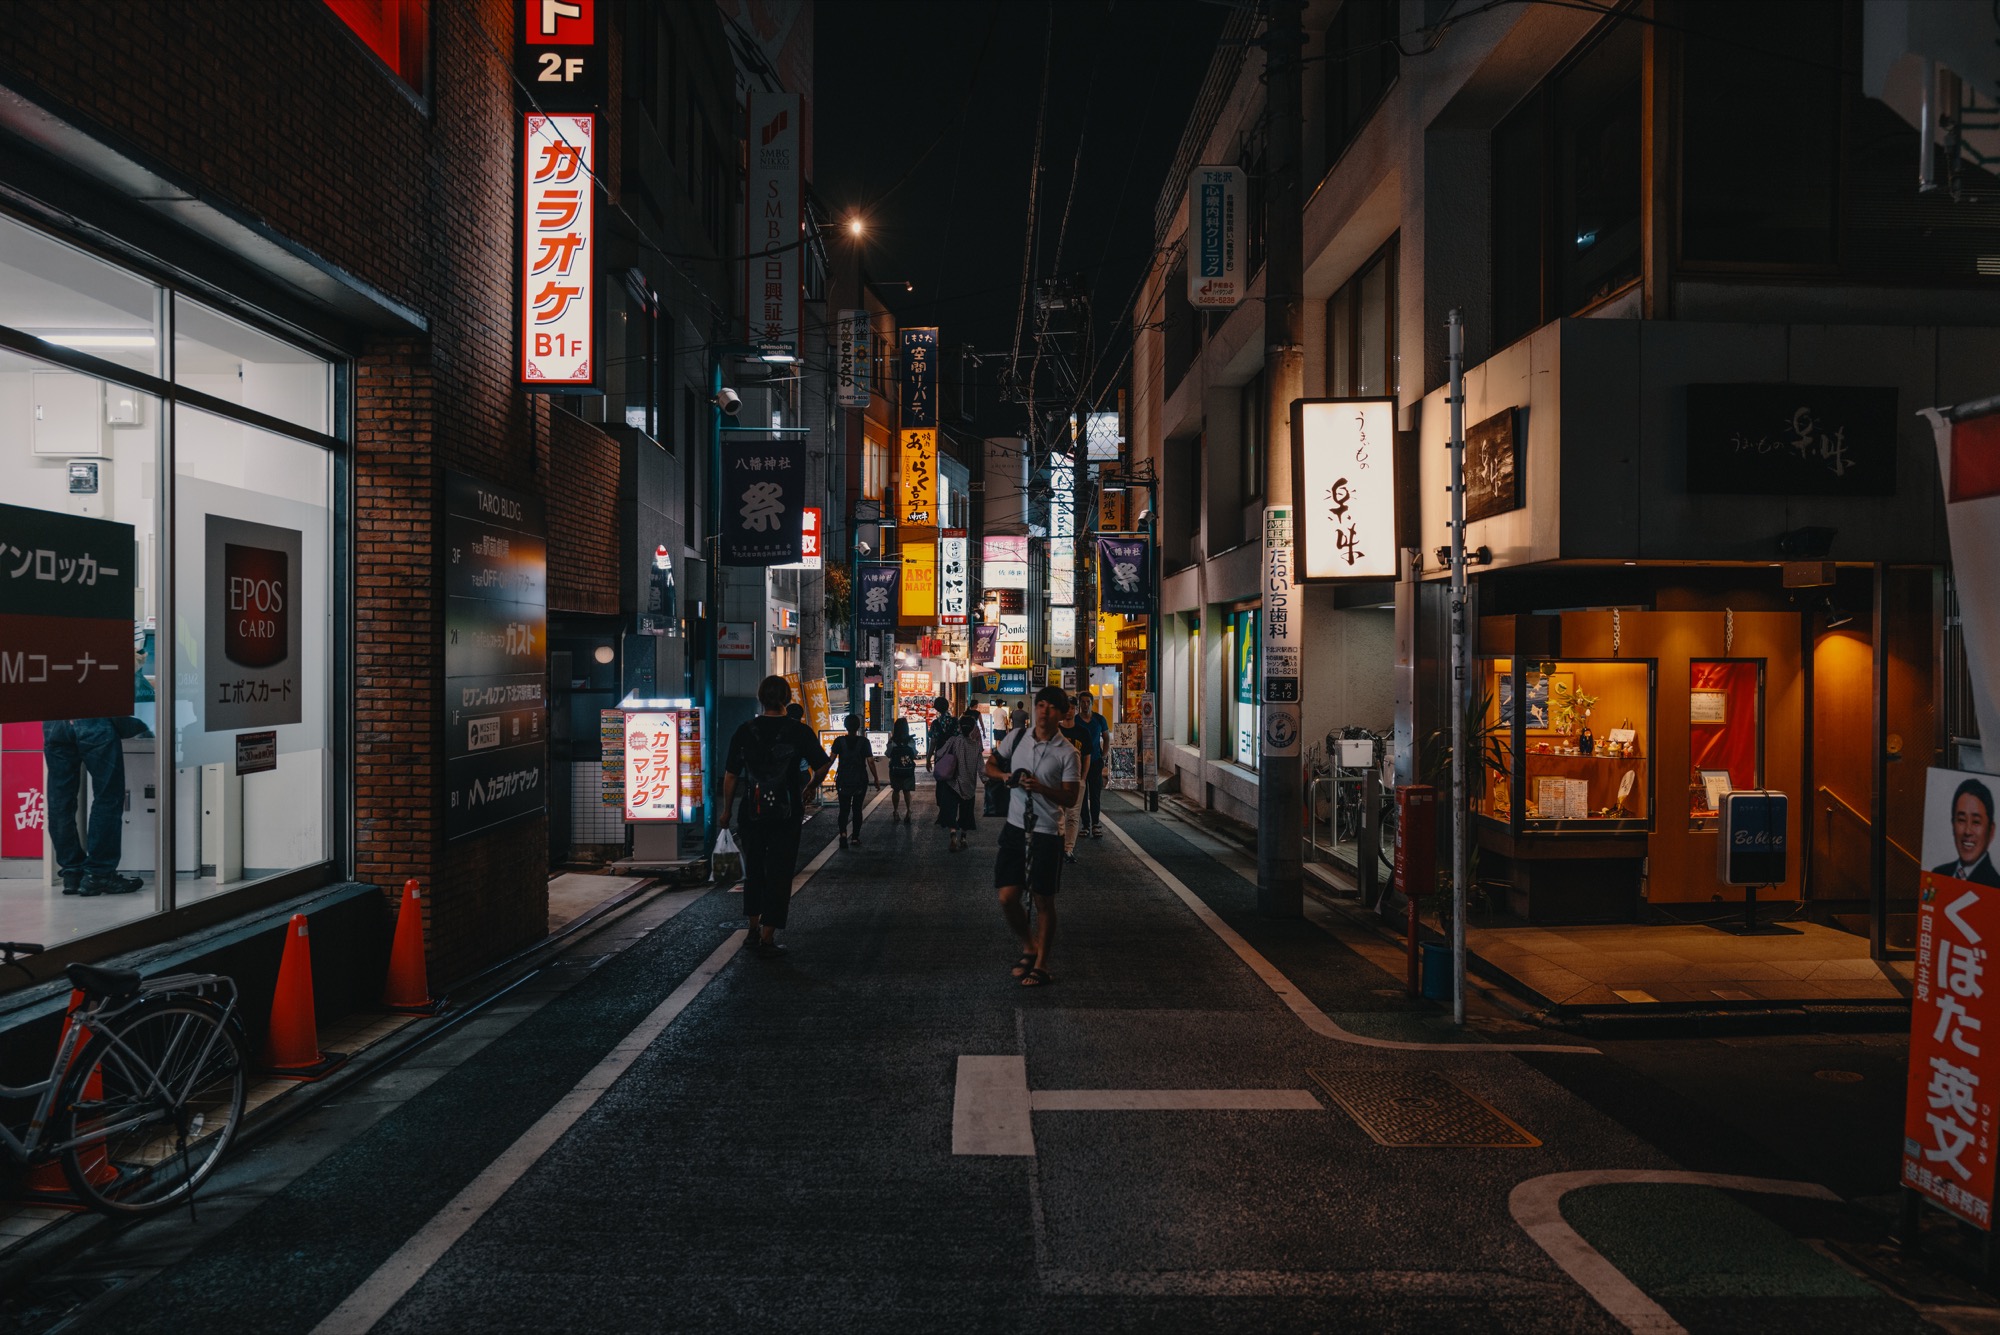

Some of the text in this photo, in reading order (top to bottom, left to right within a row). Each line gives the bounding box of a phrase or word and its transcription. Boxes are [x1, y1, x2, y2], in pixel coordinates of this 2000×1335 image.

[537, 52, 584, 82] 2F
[760, 149, 790, 158] SMBC
[760, 158, 790, 166] NIKKO
[1203, 172, 1233, 183] 下北沢
[531, 139, 587, 326] カラオケ
[1205, 185, 1220, 277] 心療内科クリニック
[534, 332, 582, 358] B1F
[905, 334, 933, 345] しもきた
[735, 456, 792, 471] 八幡神社
[477, 489, 524, 523] TARO BLDG.
[739, 481, 786, 533] 祭
[451, 547, 461, 564] 3F
[905, 568, 932, 581] ABC
[905, 582, 932, 592] MART
[230, 576, 283, 614] EPOS
[1269, 548, 1289, 639] たねいち歯科
[239, 618, 276, 639] CARD
[505, 621, 536, 656] ガスト
[1002, 645, 1023, 655] PIZZA
[218, 678, 292, 705] エポスカード
[1270, 691, 1293, 699] 2-12
[451, 709, 460, 726] 1F
[651, 731, 671, 799] カラオケ
[486, 766, 540, 803] カラオケマック
[632, 757, 650, 808] マック
[451, 789, 460, 809] B1
[1734, 829, 1754, 845] Be
[1916, 913, 1933, 1003] 自由民主党
[1933, 889, 1988, 1059] くぼた
[1924, 1055, 1981, 1182] 英文
[1904, 1157, 1990, 1226] 後援会事務所
